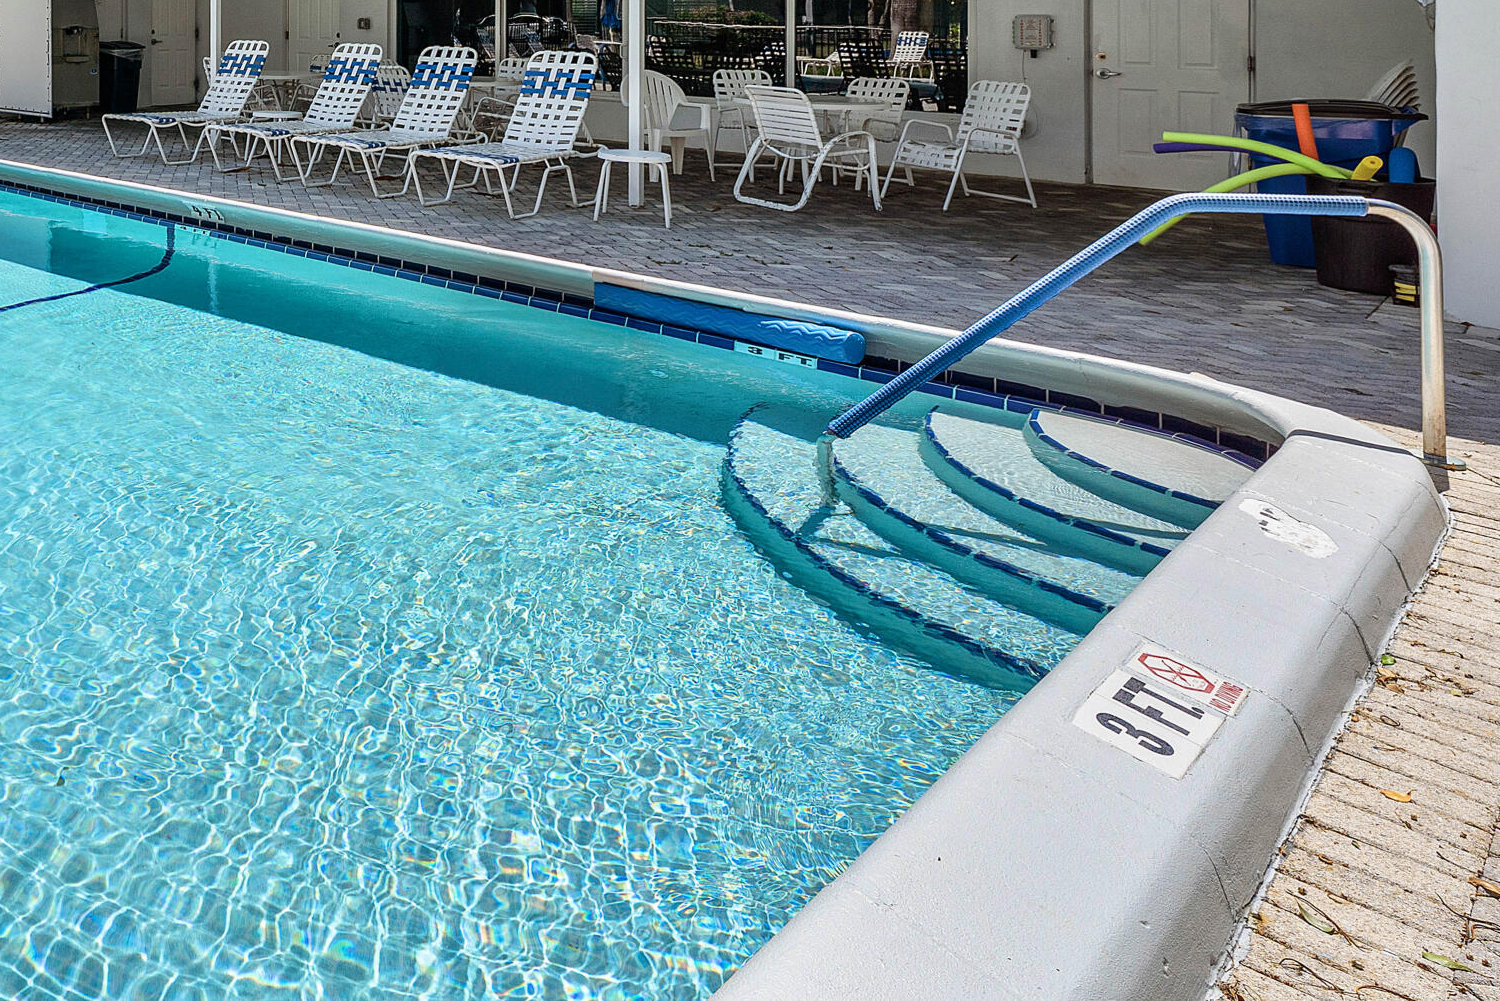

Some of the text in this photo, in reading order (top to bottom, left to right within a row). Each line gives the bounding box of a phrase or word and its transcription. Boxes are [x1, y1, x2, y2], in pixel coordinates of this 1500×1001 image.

[747, 345, 813, 367] 3 FT.
[1209, 681, 1244, 713] NO DIVING
[1096, 677, 1205, 756] 3 FT.
